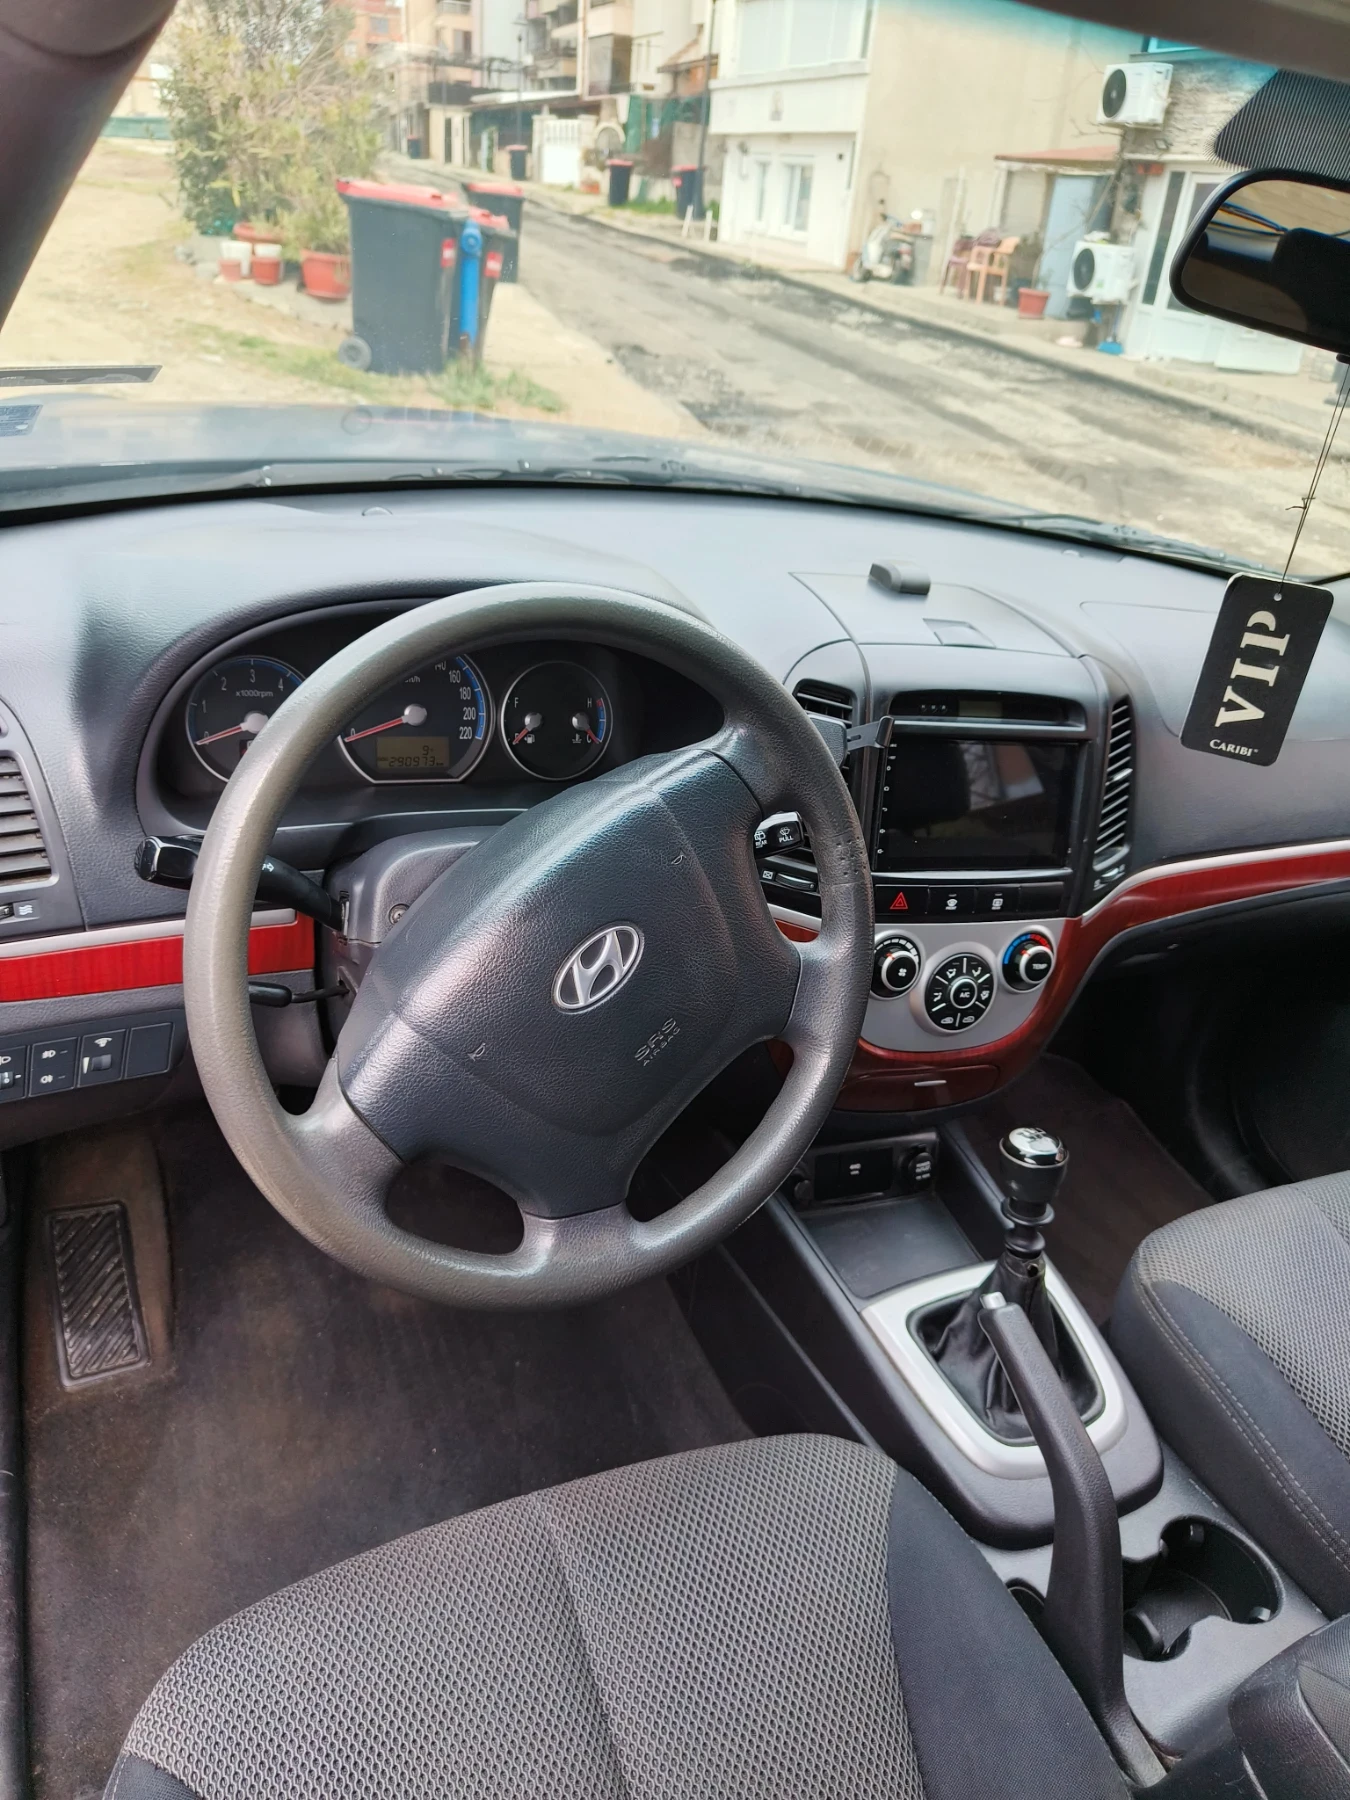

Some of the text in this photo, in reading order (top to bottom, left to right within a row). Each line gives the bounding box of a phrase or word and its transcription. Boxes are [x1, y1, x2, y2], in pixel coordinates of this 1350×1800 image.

[1214, 610, 1290, 728] VIP
[250, 669, 256, 683] 3
[449, 670, 461, 683] 160
[221, 677, 227, 691] 2
[278, 678, 284, 691] 4
[459, 687, 471, 700] 180
[202, 700, 207, 713] 1
[514, 697, 519, 708] F
[587, 697, 592, 708] H
[463, 707, 476, 720] 200
[459, 727, 473, 740] 220
[634, 1018, 677, 1061] SRS
